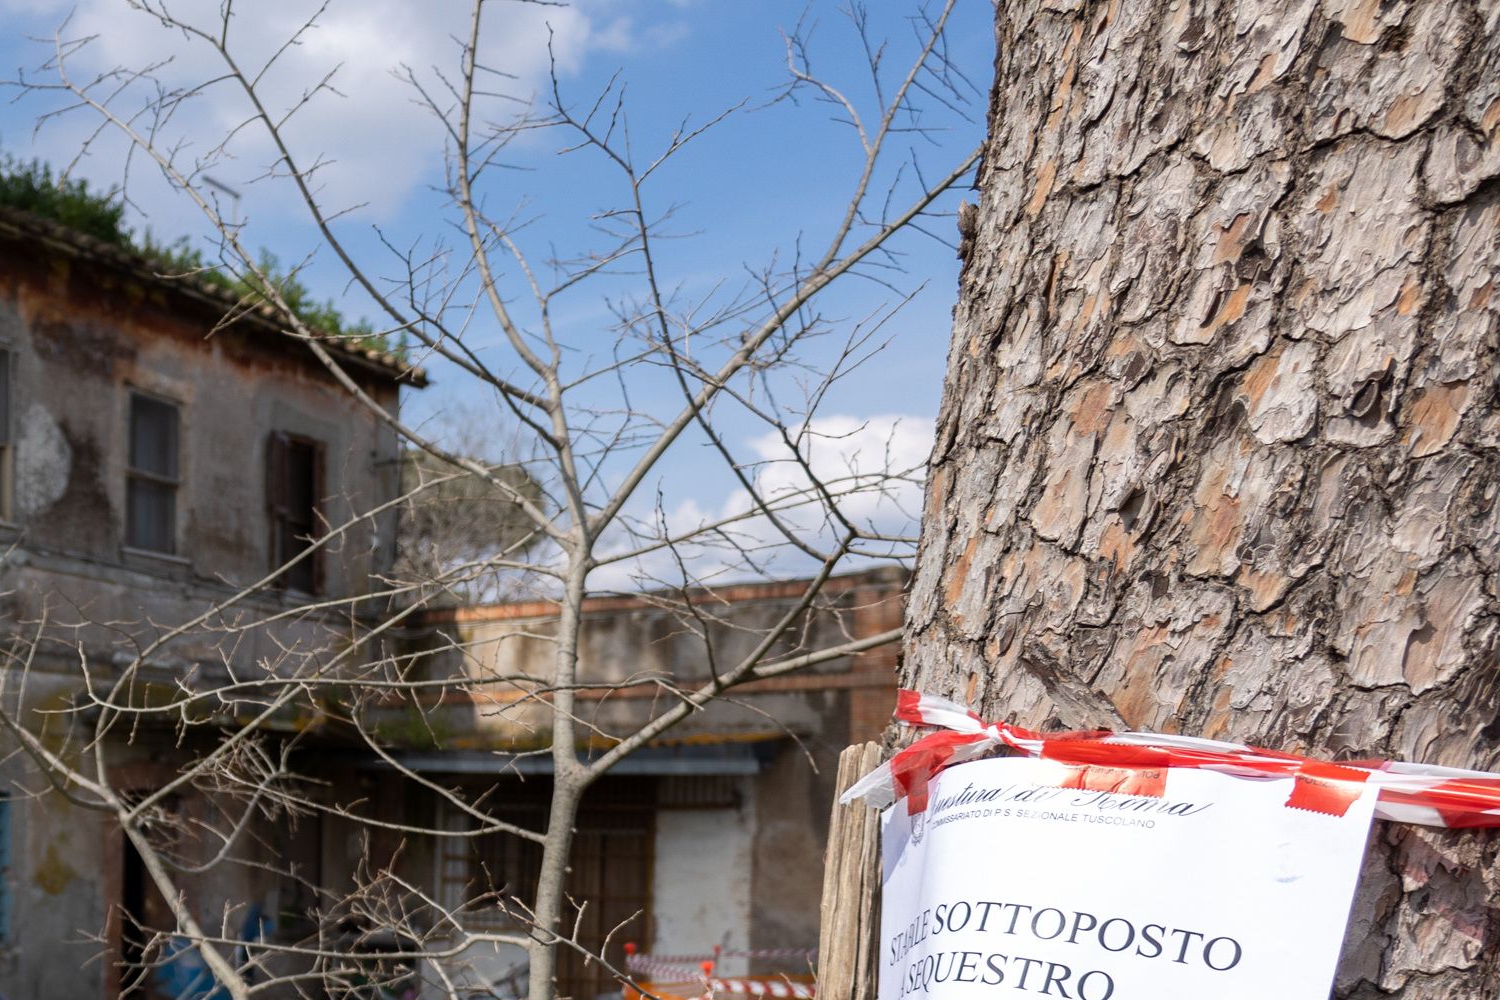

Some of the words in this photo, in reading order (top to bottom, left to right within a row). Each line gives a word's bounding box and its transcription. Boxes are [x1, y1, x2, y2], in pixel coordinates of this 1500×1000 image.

[926, 782, 1014, 823] Questura
[1070, 790, 1212, 817] Roma
[983, 809, 993, 818] DI
[1016, 808, 1078, 823] SEZIONALE
[1083, 814, 1156, 829] TUSCOLANO
[932, 901, 1243, 972] SOTTOPOSTO
